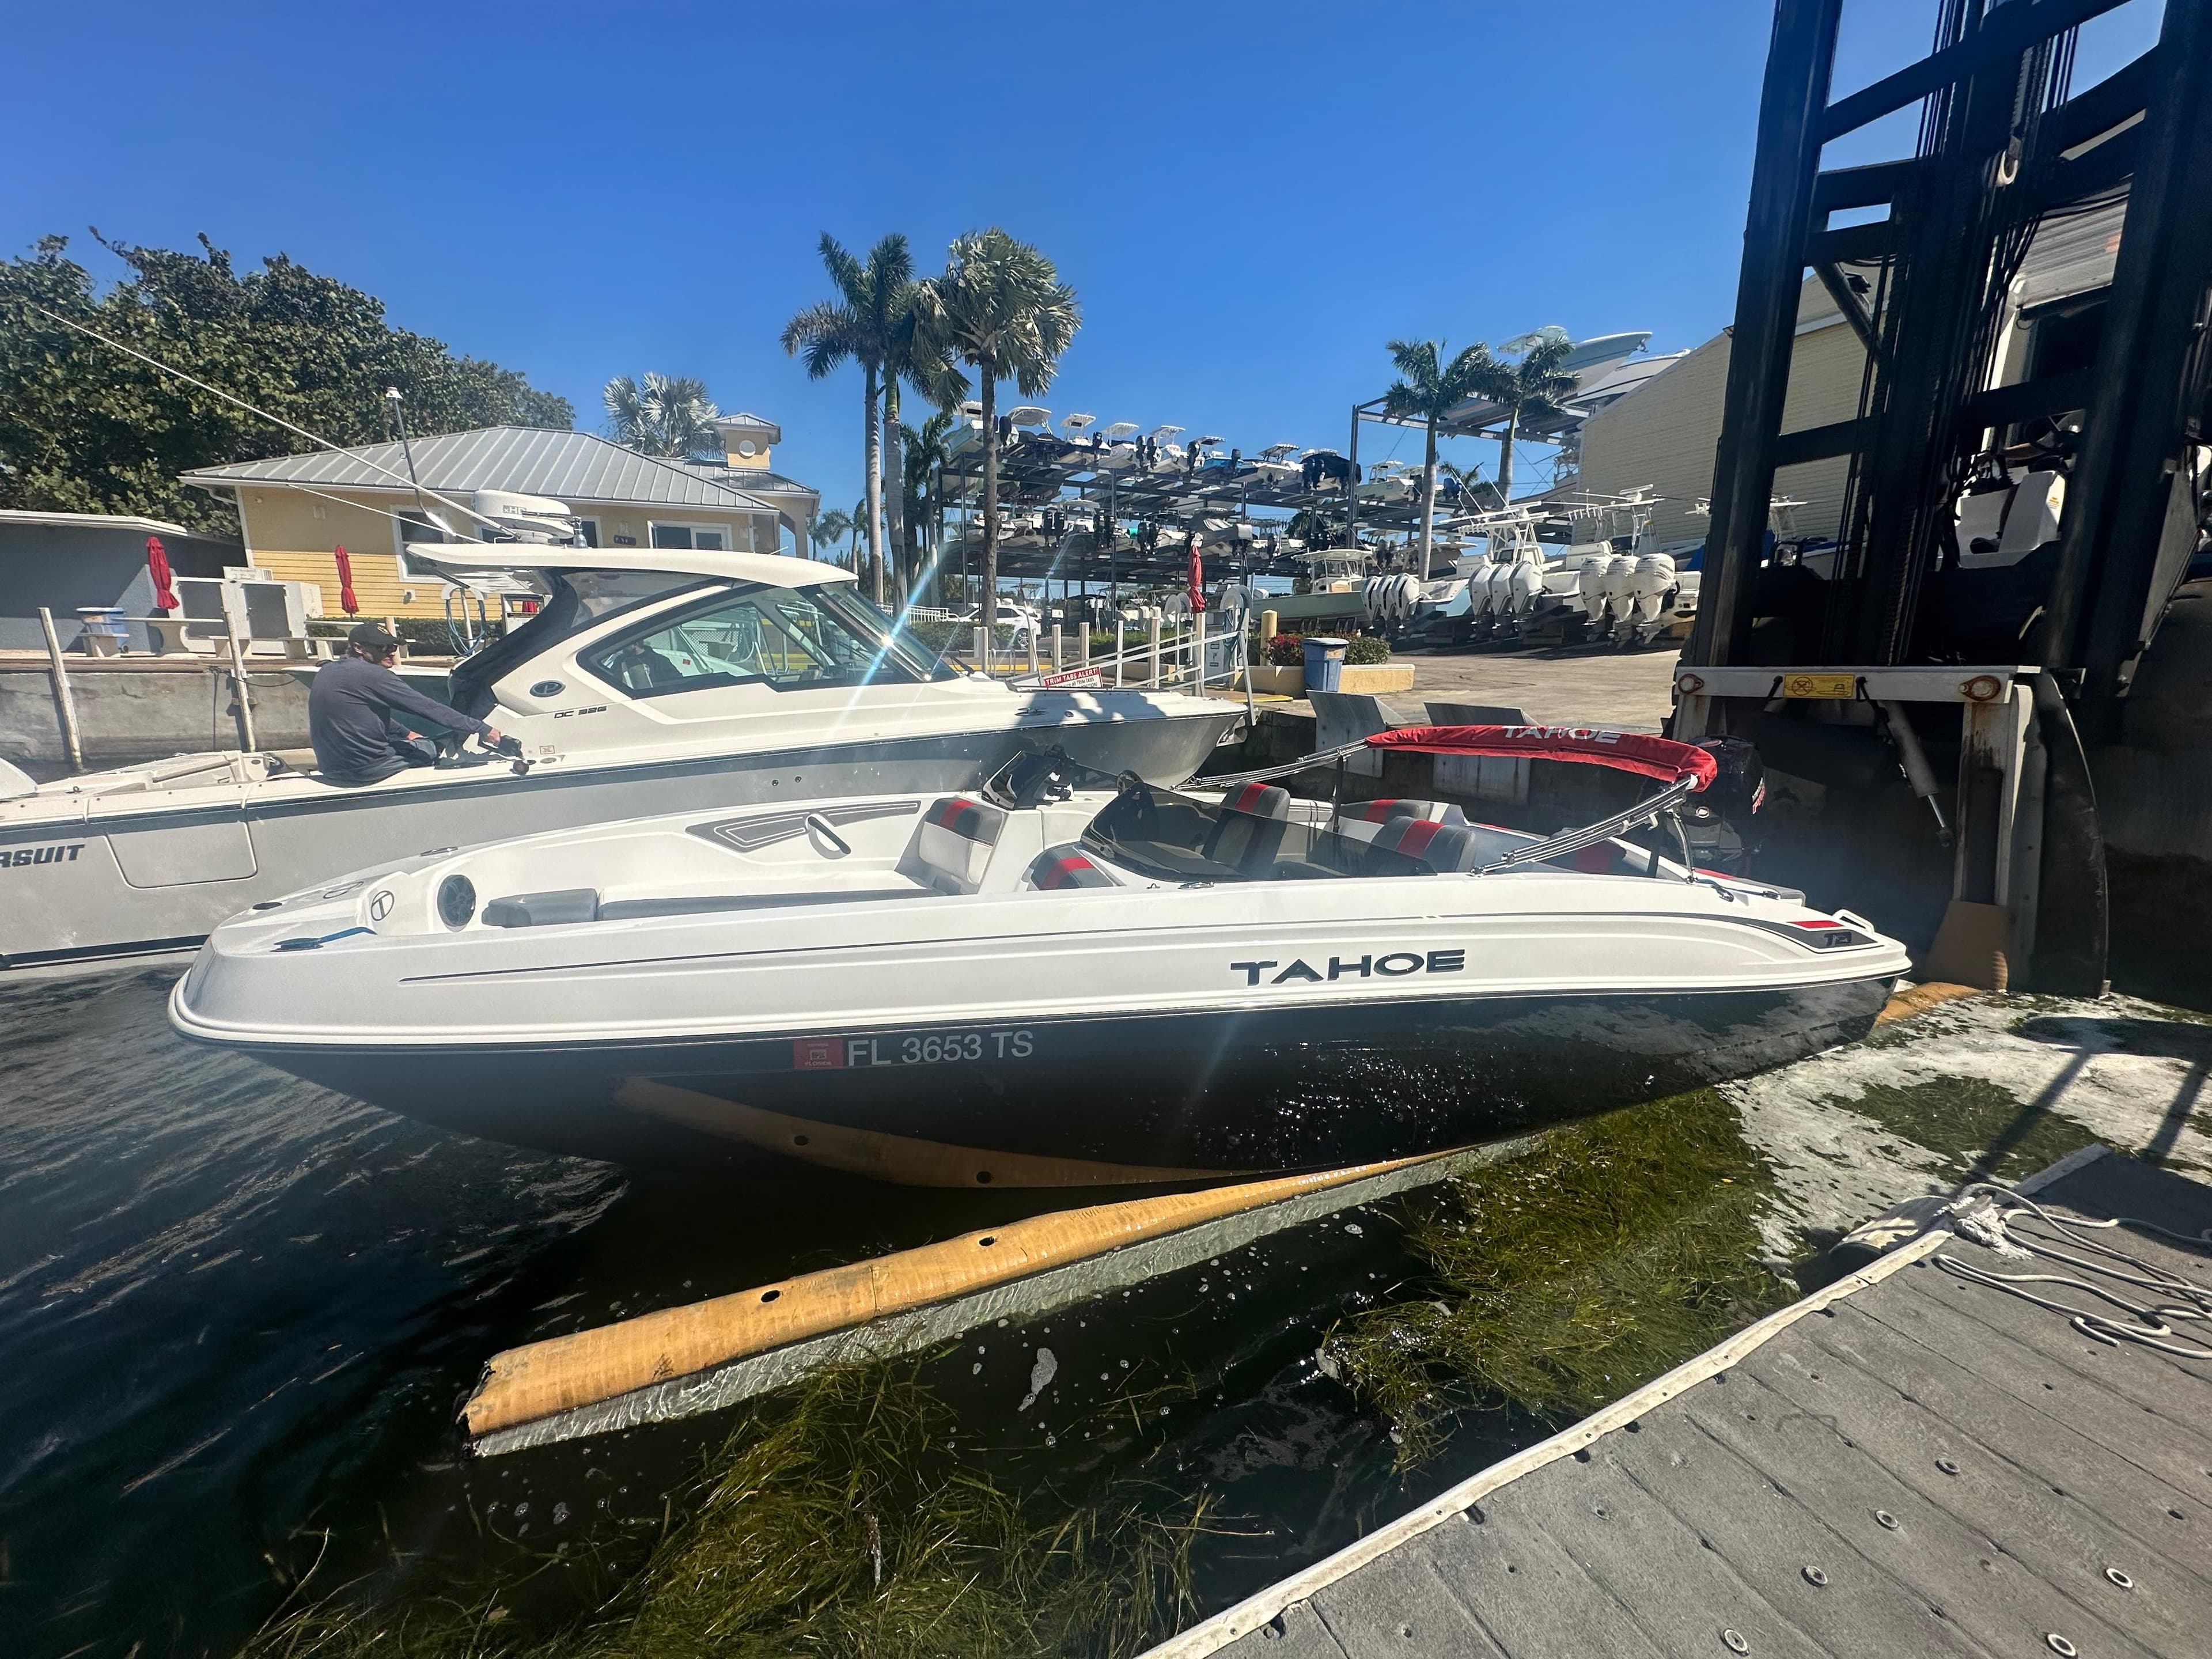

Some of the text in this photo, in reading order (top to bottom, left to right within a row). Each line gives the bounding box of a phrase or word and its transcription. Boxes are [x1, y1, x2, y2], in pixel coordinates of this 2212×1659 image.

[1046, 668, 1099, 685] TRIM TABS ALERT!
[554, 711, 574, 719] DC
[1502, 726, 1621, 744] TAHOE
[1230, 949, 1465, 986] TAHOE
[848, 1030, 1034, 1066] FL 3653 TS
